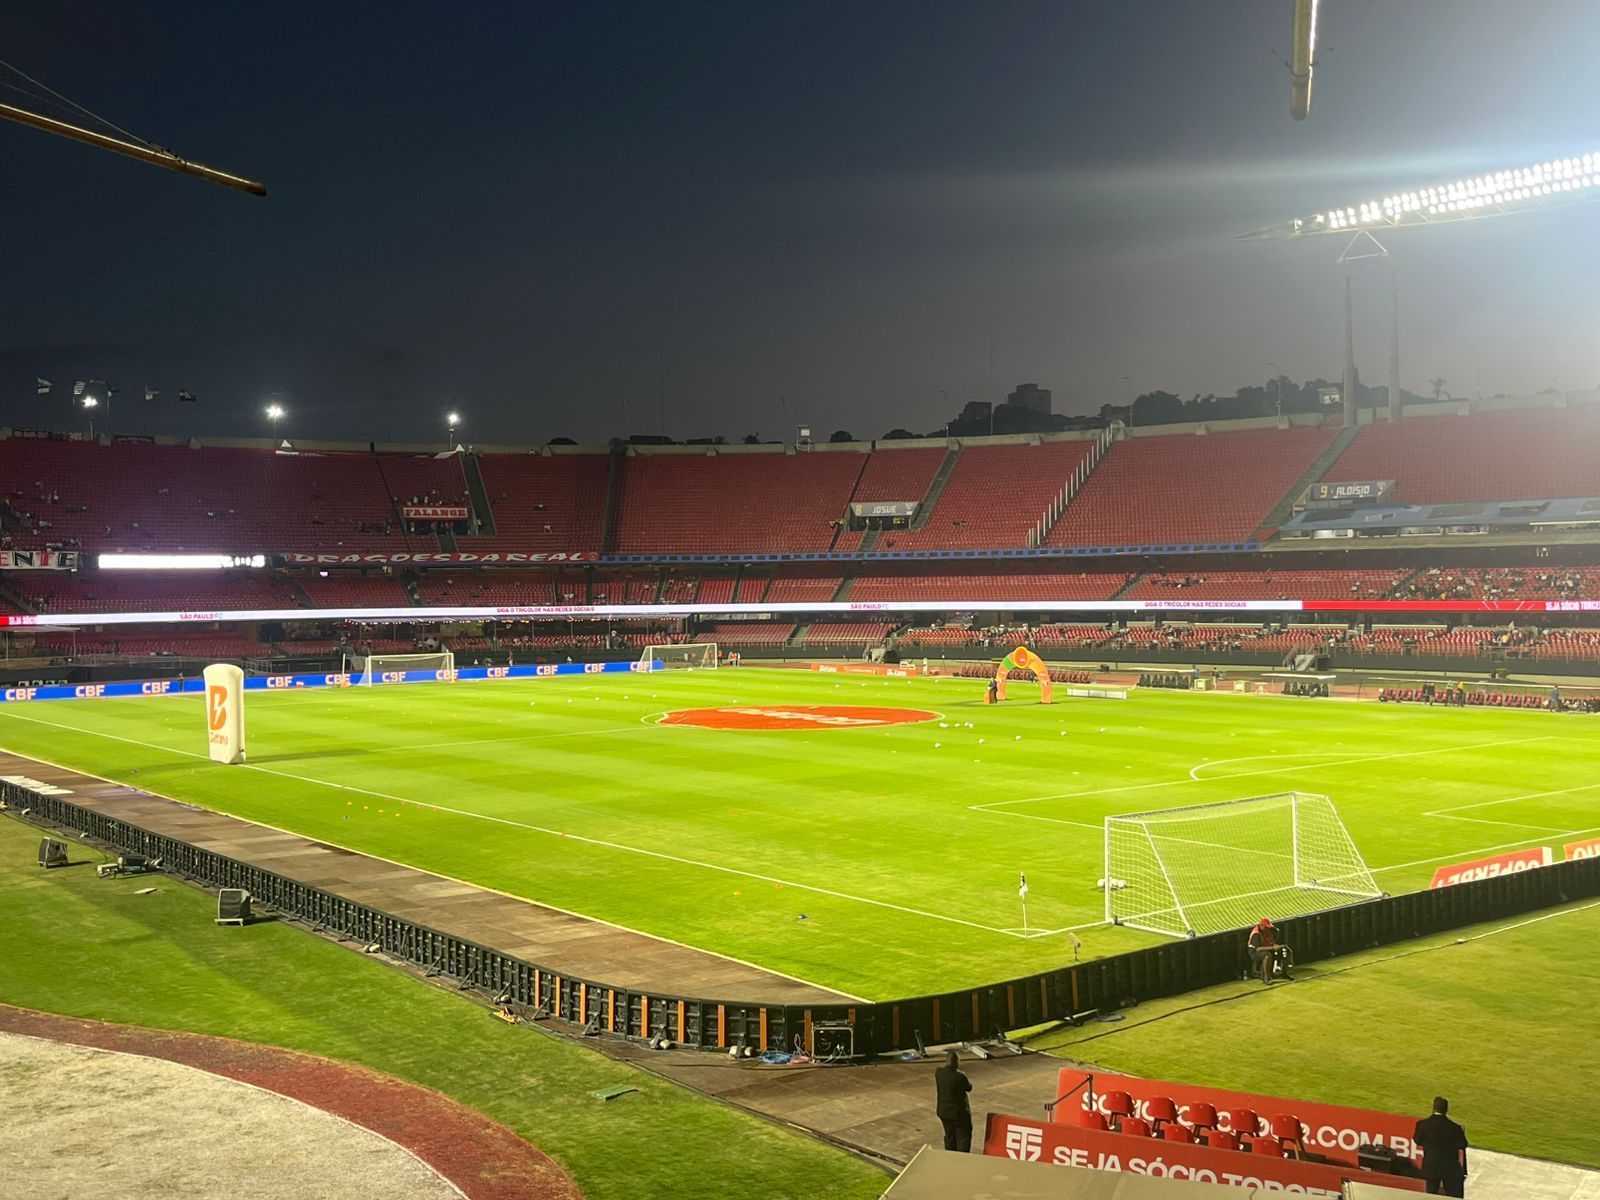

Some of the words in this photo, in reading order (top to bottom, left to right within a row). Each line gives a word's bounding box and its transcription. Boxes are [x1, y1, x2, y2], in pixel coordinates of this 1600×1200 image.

[1320, 485, 1328, 498] 9
[405, 509, 466, 517] FALANGE
[458, 553, 500, 562] DA
[506, 552, 585, 561] REAL
[5, 688, 36, 701] CBF
[75, 685, 105, 697] CBF
[142, 681, 170, 693] CBF
[266, 676, 292, 688] CBF
[487, 667, 509, 678] CBF
[536, 665, 558, 676] CBF
[584, 663, 606, 673] CBF
[630, 661, 650, 672] CBF
[1053, 1146, 1121, 1172] SEJA
[1128, 1157, 1218, 1184] SÓCIO
